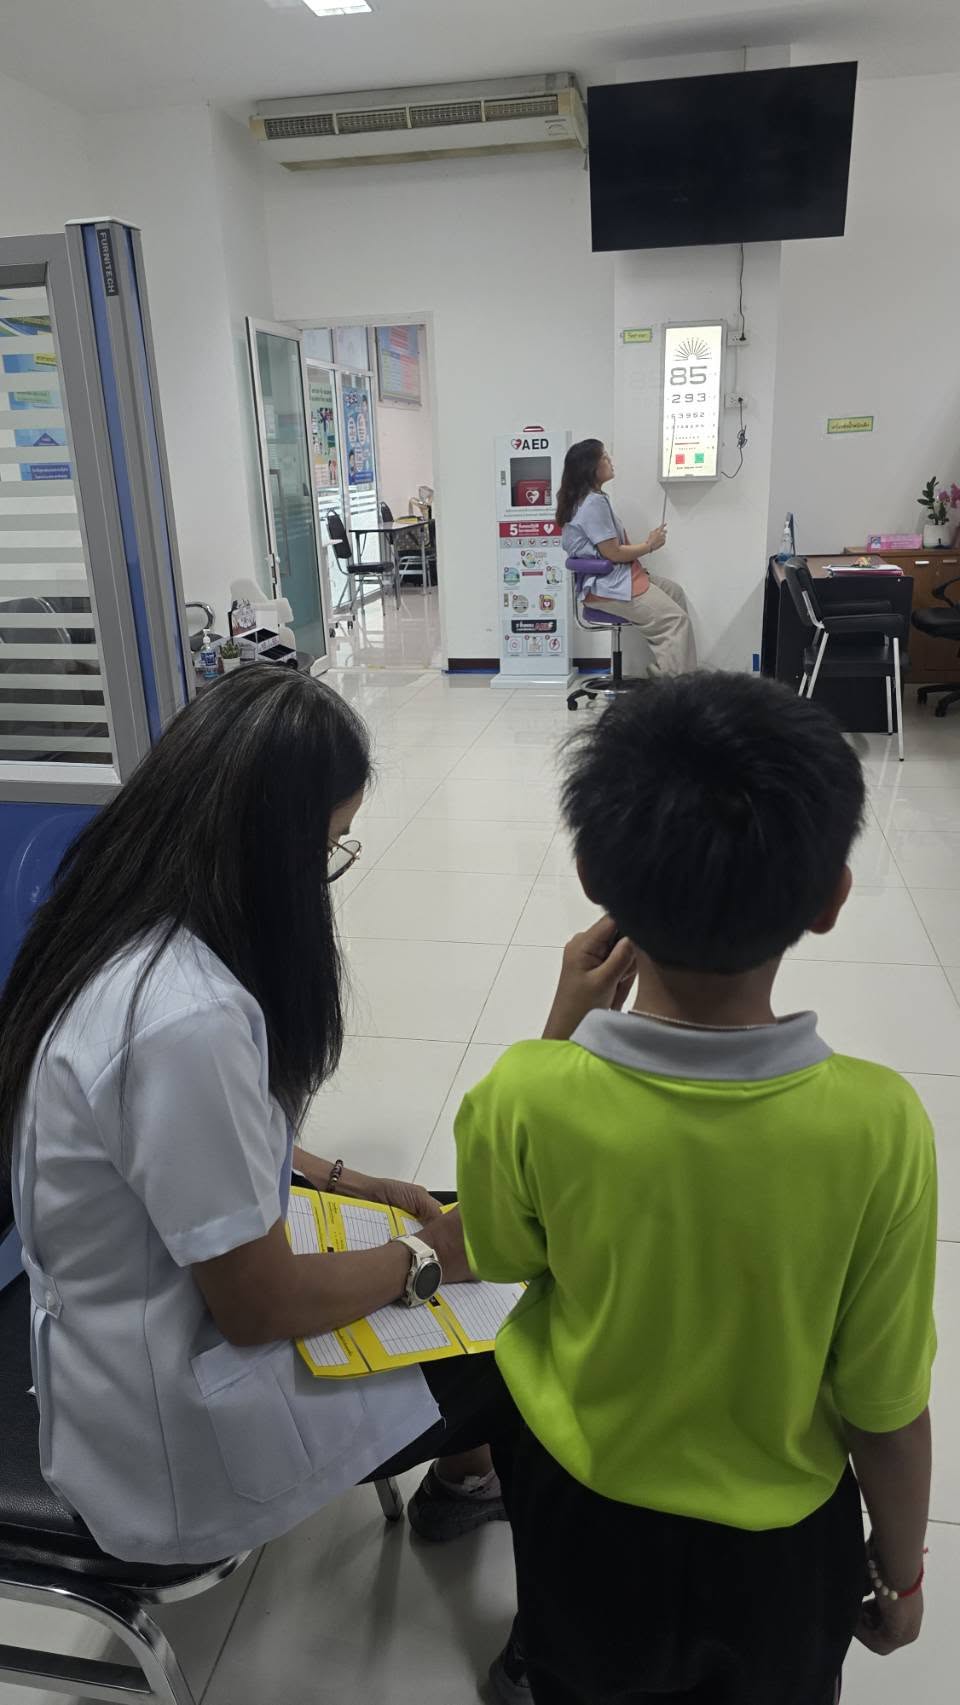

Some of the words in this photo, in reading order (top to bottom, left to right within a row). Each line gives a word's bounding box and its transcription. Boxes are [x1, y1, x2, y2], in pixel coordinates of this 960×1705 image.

[99, 231, 115, 293] FURNITECH
[670, 365, 708, 386] 85
[671, 392, 706, 404] 293
[522, 438, 549, 450] AED
[509, 523, 518, 536] 5
